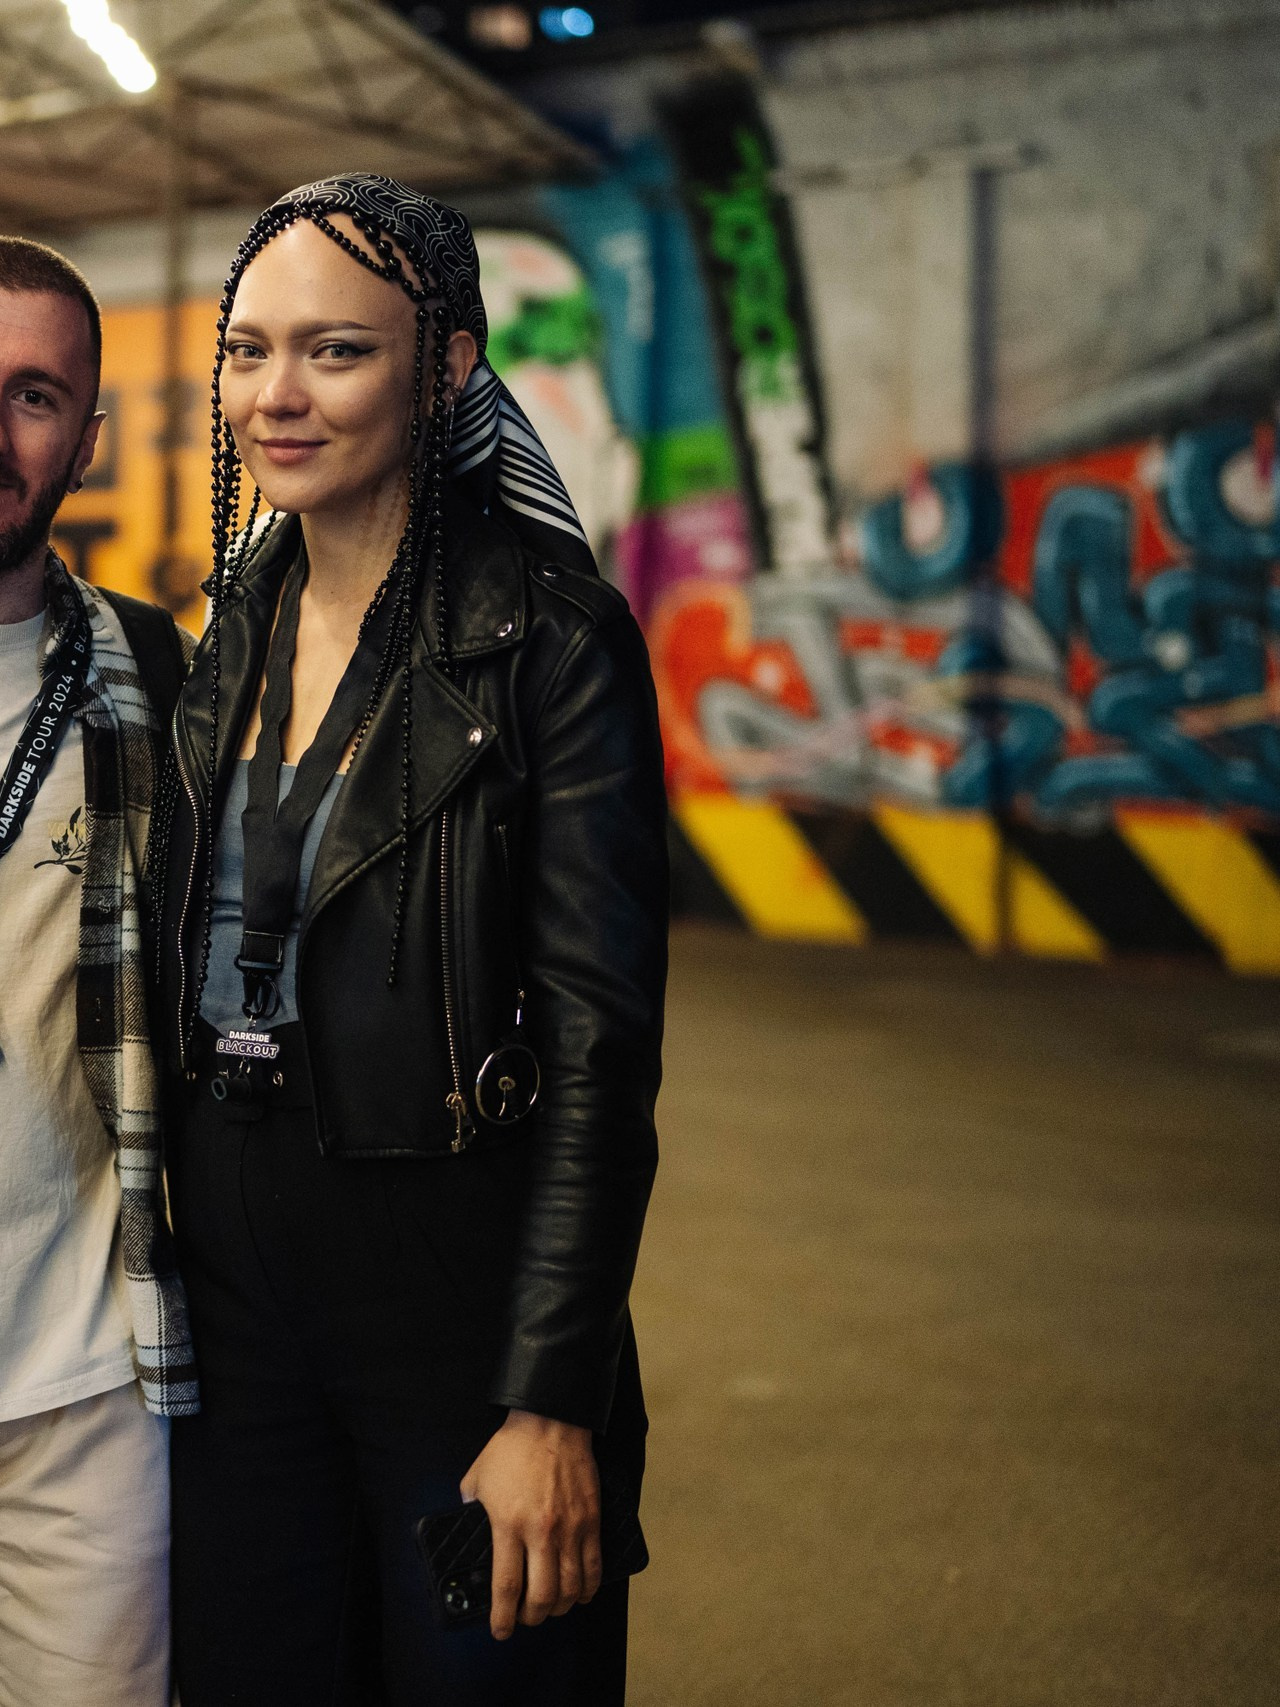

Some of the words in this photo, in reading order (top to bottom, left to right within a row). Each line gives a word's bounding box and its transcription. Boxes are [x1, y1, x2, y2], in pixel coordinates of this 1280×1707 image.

[26, 715, 58, 761] TOUR
[48, 674, 75, 713] 2024
[228, 1030, 270, 1043] DARKSIDE
[218, 1040, 277, 1057] BLACKOUT
